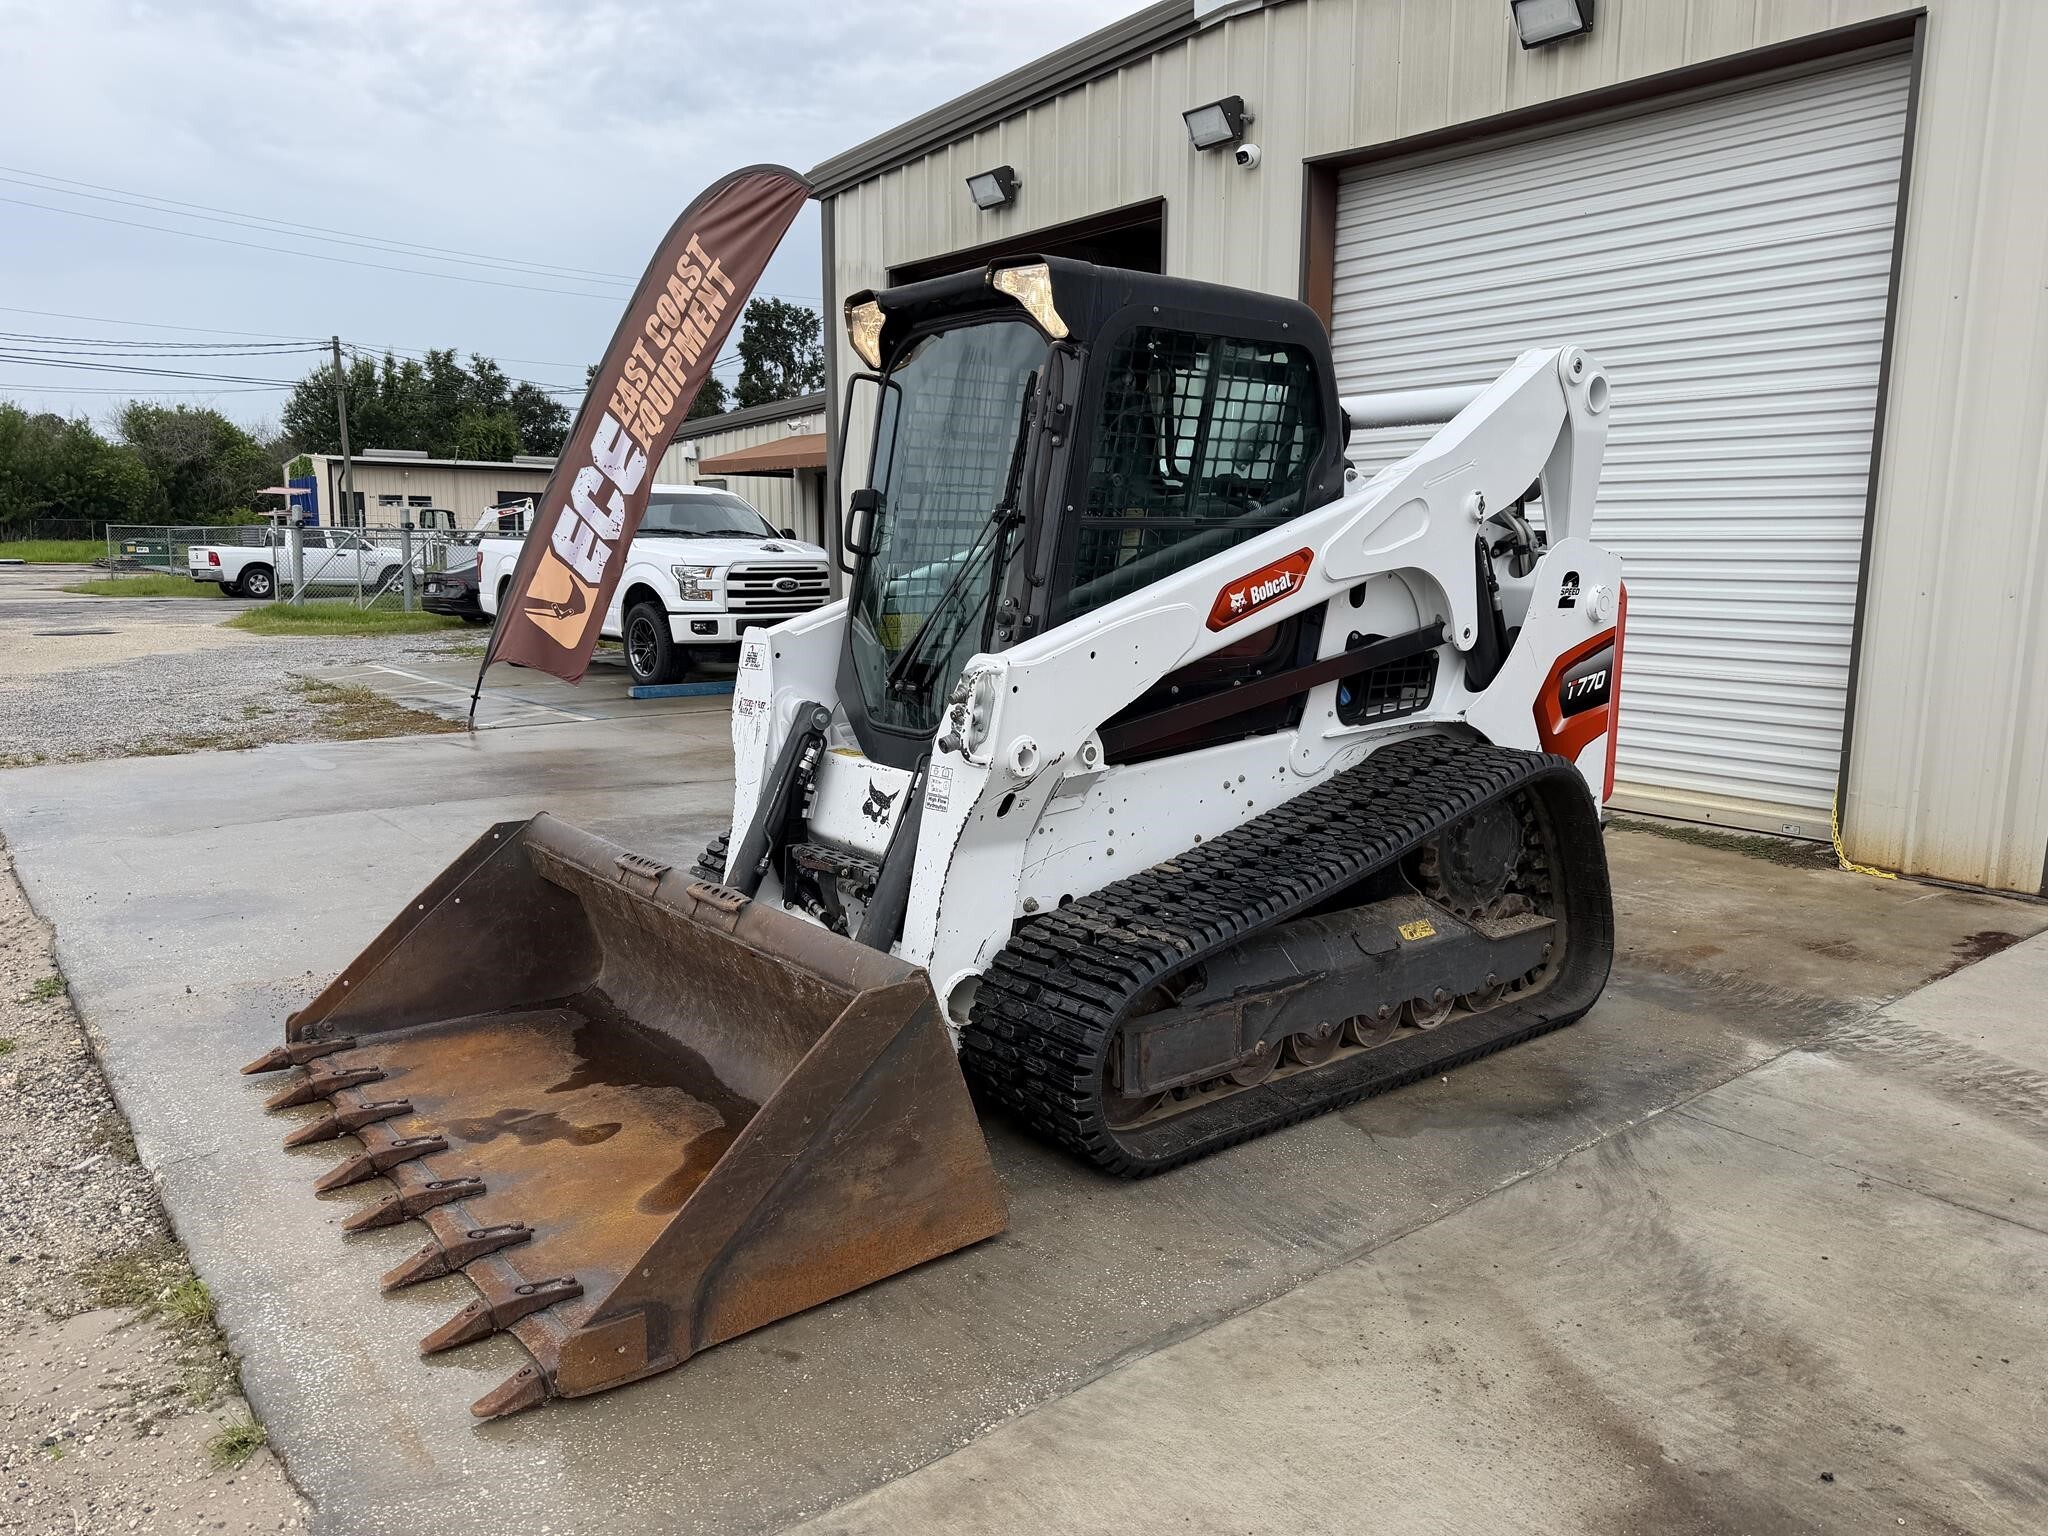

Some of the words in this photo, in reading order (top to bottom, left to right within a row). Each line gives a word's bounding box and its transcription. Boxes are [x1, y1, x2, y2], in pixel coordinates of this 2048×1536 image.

[608, 337, 657, 428] EAST
[645, 233, 712, 350] COAST
[630, 258, 736, 454] EQUIPMENT
[551, 411, 648, 583] ECE
[1250, 571, 1292, 605] Bobcat
[1560, 588, 1580, 596] SPEED
[1568, 670, 1606, 700] T770
